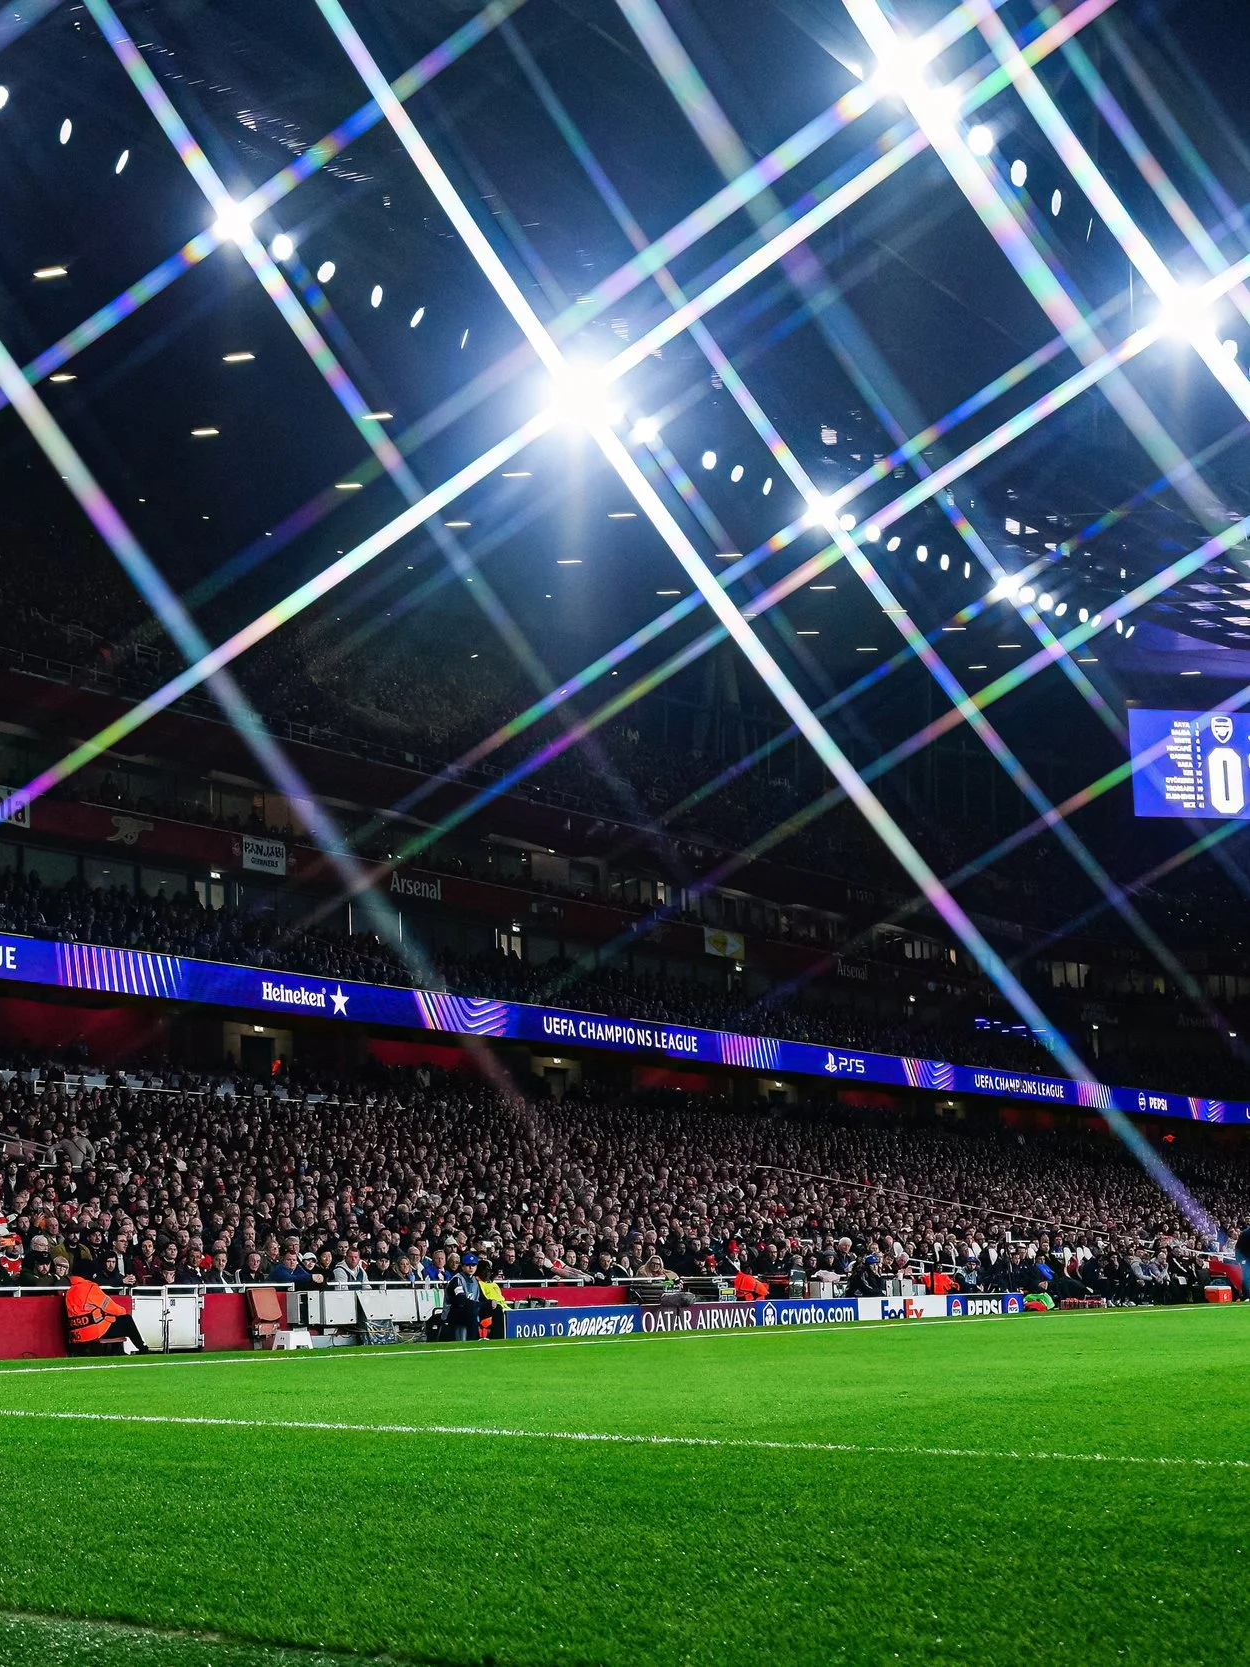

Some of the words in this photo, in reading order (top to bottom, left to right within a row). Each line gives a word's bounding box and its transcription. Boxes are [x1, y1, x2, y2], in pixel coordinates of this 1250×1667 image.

[1208, 748, 1244, 813] 0
[244, 842, 284, 858] PANJABI
[390, 870, 442, 901] Arsenal
[837, 959, 868, 981] Arsenal
[262, 981, 326, 1008] Heineken
[543, 1016, 577, 1037] UEFA
[579, 1021, 652, 1047] CHAMPIONS
[654, 1031, 698, 1053] LEAGUE
[838, 1057, 866, 1074] PS5
[974, 1073, 995, 1090] UEFA
[994, 1076, 1038, 1096] CHAMPIONS
[1037, 1082, 1065, 1099] LEAGUE
[1149, 1096, 1168, 1111] PEPSI
[516, 1324, 546, 1338] ROAD
[549, 1323, 564, 1336] TO
[567, 1315, 621, 1337] BUDAPEST
[619, 1314, 635, 1335] 26
[642, 1310, 693, 1333] QATAR
[696, 1308, 757, 1330] AIRWAYS
[780, 1304, 854, 1325] crypto.com
